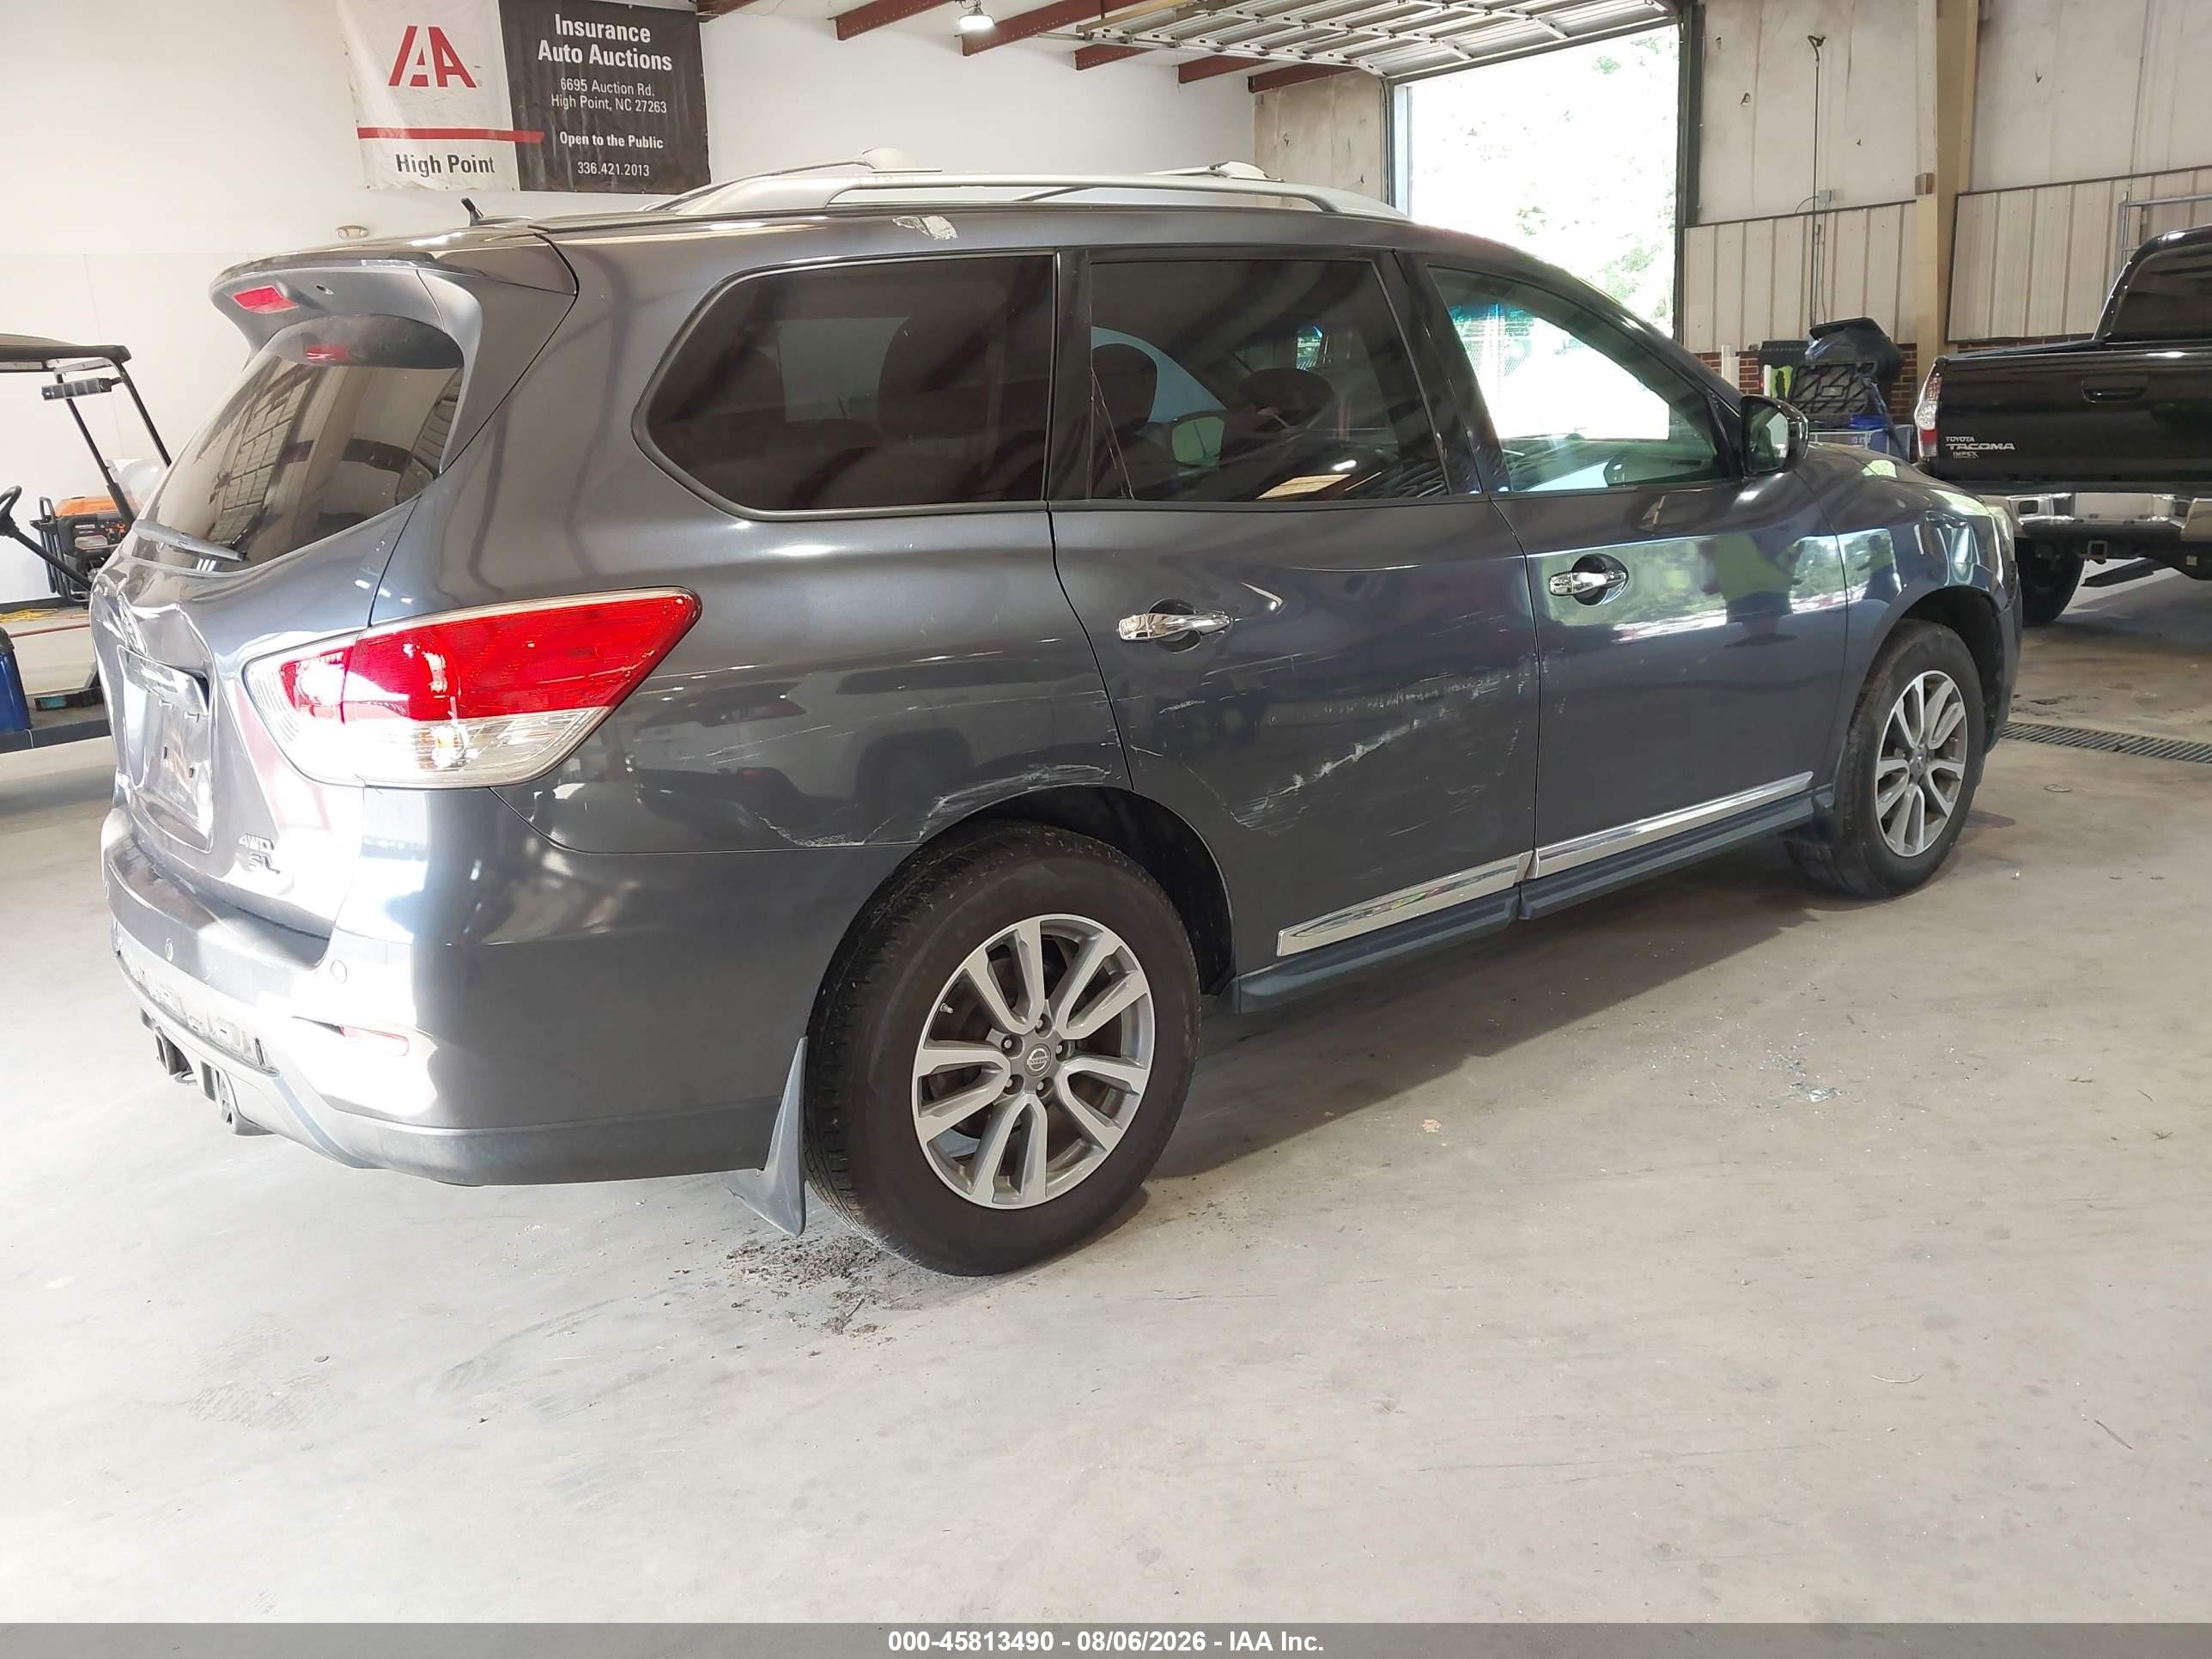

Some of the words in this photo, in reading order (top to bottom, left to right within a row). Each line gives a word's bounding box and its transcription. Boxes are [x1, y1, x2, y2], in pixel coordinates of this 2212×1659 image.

[555, 14, 651, 43] Insurance
[538, 40, 583, 64] Auto
[588, 44, 672, 71] Auctions
[561, 77, 588, 92] 6695
[591, 79, 635, 95] Auction
[637, 82, 655, 96] Rd.
[550, 94, 576, 110] High
[580, 95, 612, 112] Point,
[615, 98, 632, 112] NC
[635, 99, 667, 113] 27263
[559, 131, 589, 148] Open
[592, 134, 604, 146] to
[606, 134, 625, 147] the
[628, 135, 664, 149] Public
[395, 154, 441, 178] High
[447, 155, 495, 173] Point
[577, 161, 650, 177] 336.421.2013
[239, 833, 275, 853] 4WD
